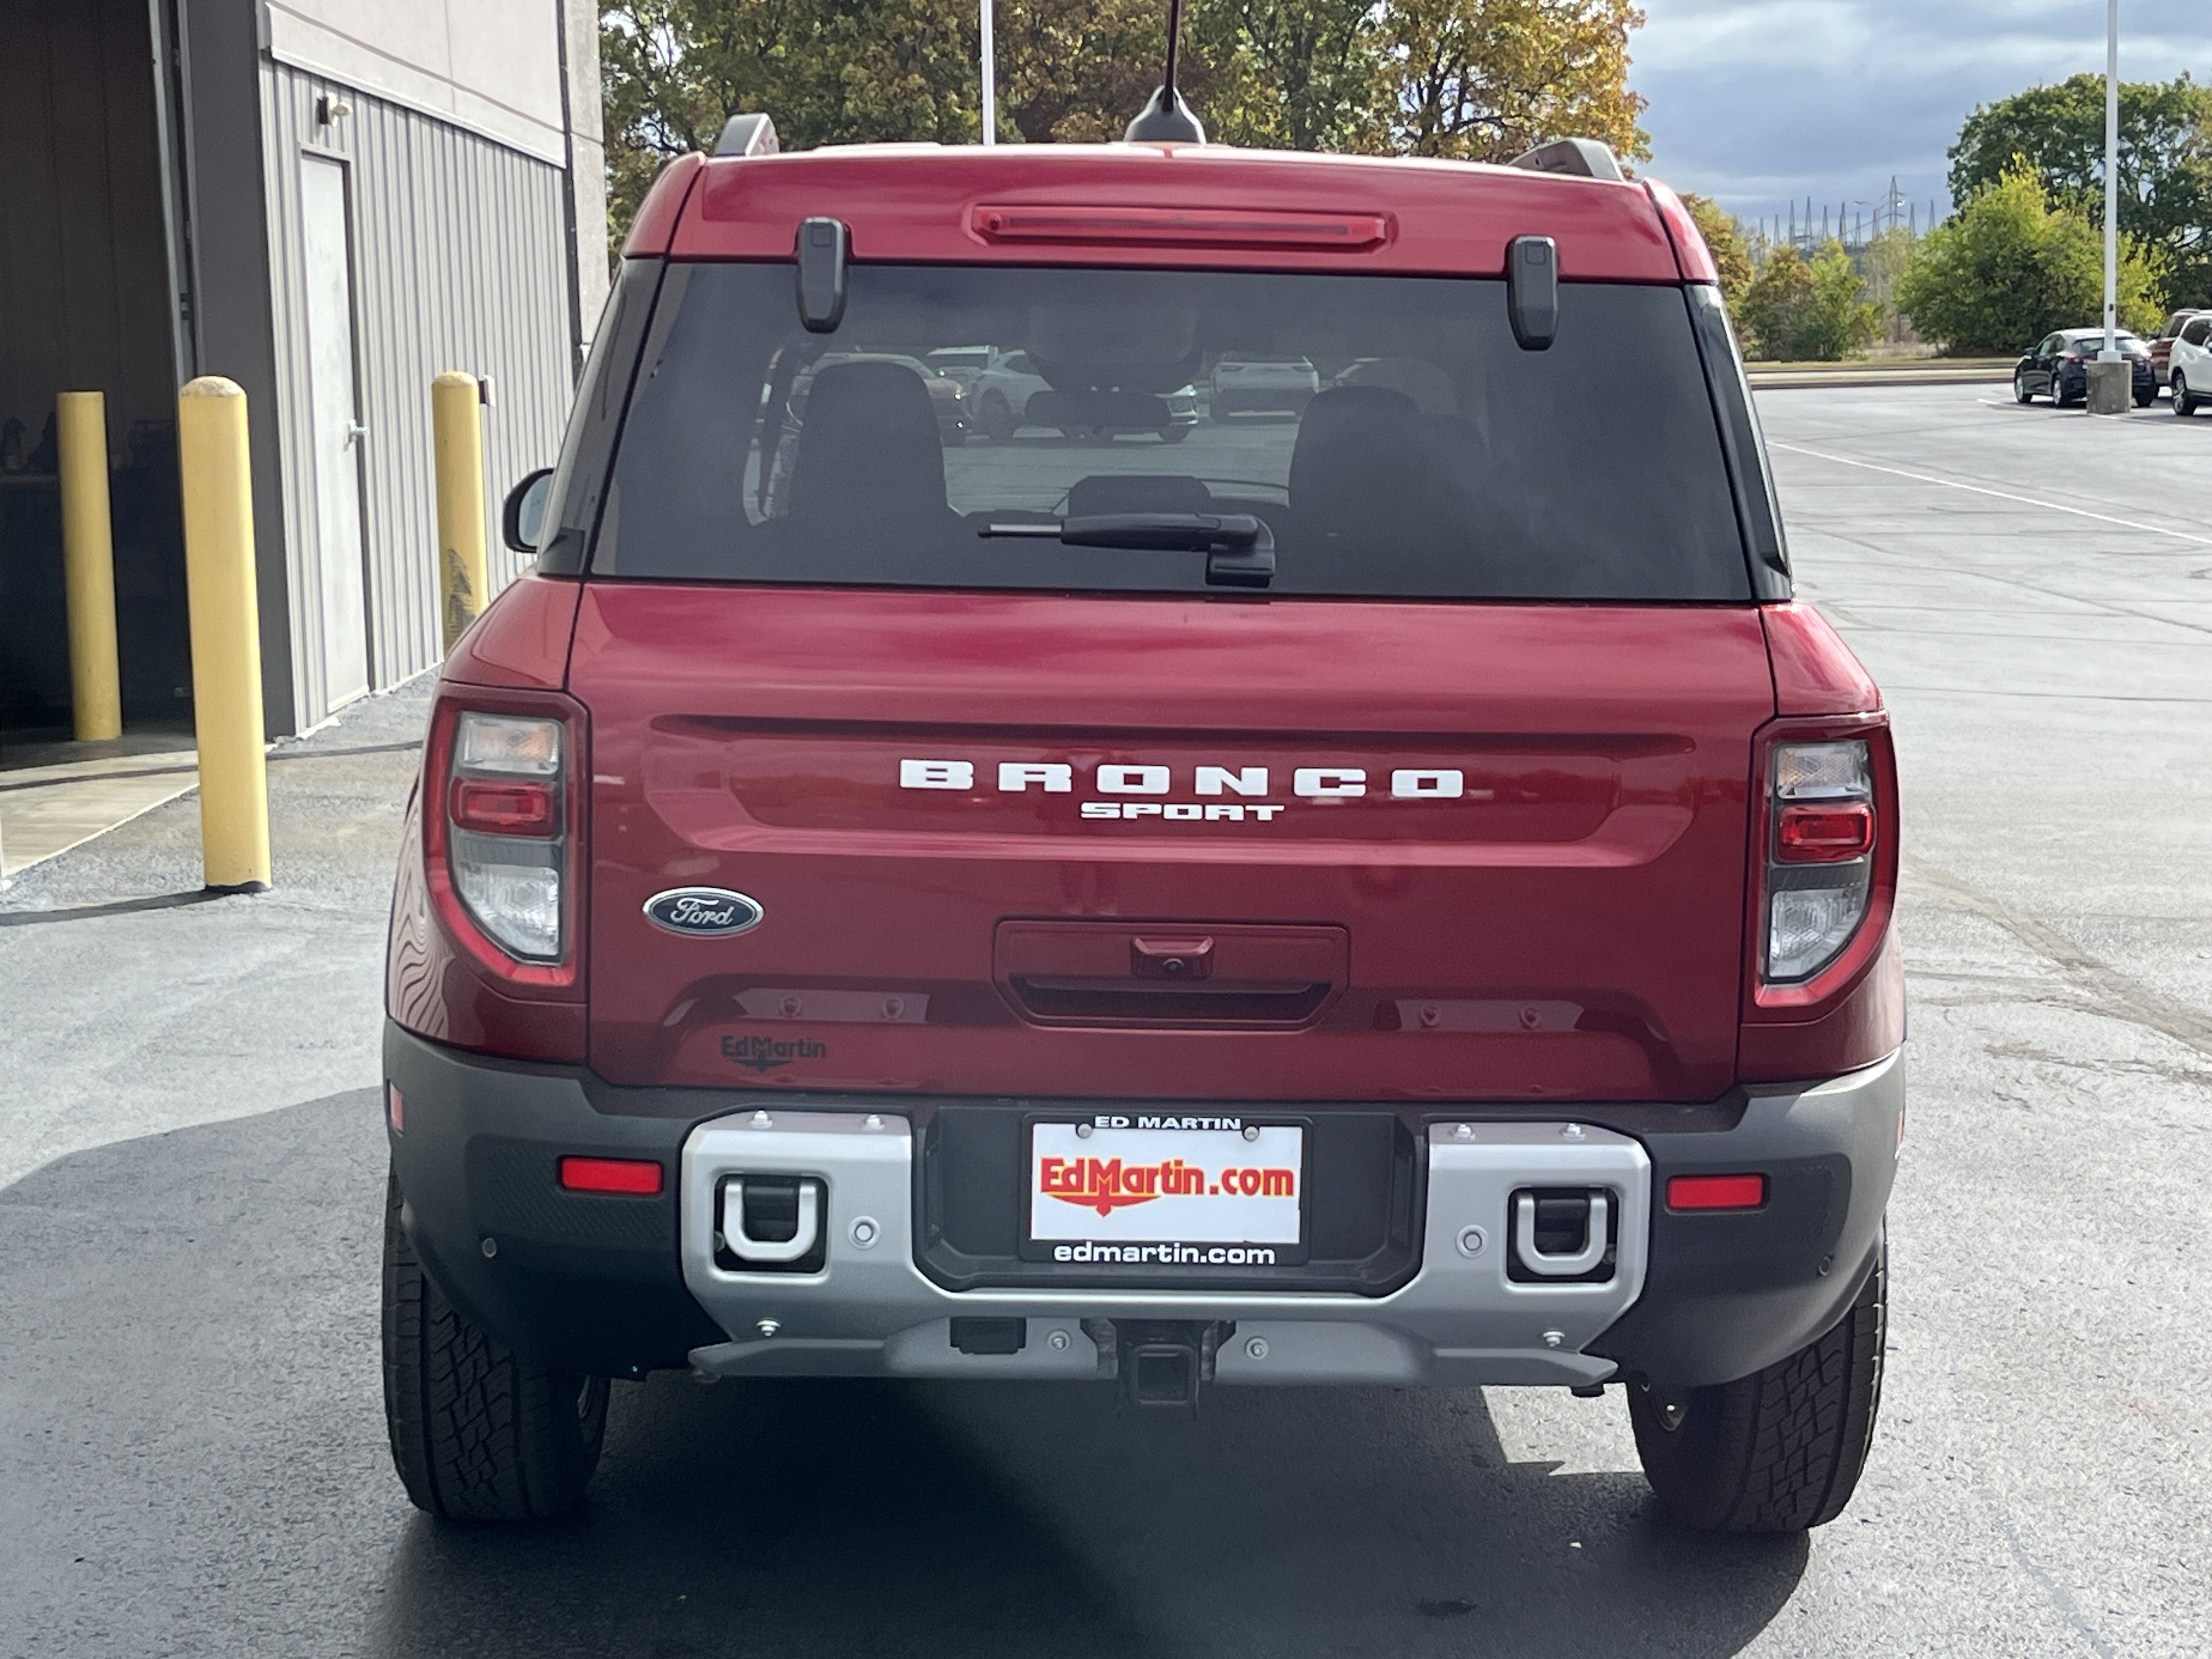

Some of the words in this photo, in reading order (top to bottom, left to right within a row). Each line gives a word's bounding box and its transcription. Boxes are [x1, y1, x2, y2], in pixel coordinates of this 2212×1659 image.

[899, 759, 1464, 799] BRONCO
[1080, 802, 1285, 821] SPORT
[669, 896, 736, 925] Ford
[721, 1035, 826, 1058] EdMartin
[1094, 1116, 1130, 1129] ED
[1137, 1116, 1242, 1131] MARTIN
[1040, 1157, 1295, 1197] EdMartin.com
[1053, 1241, 1276, 1265] edmartin.com
